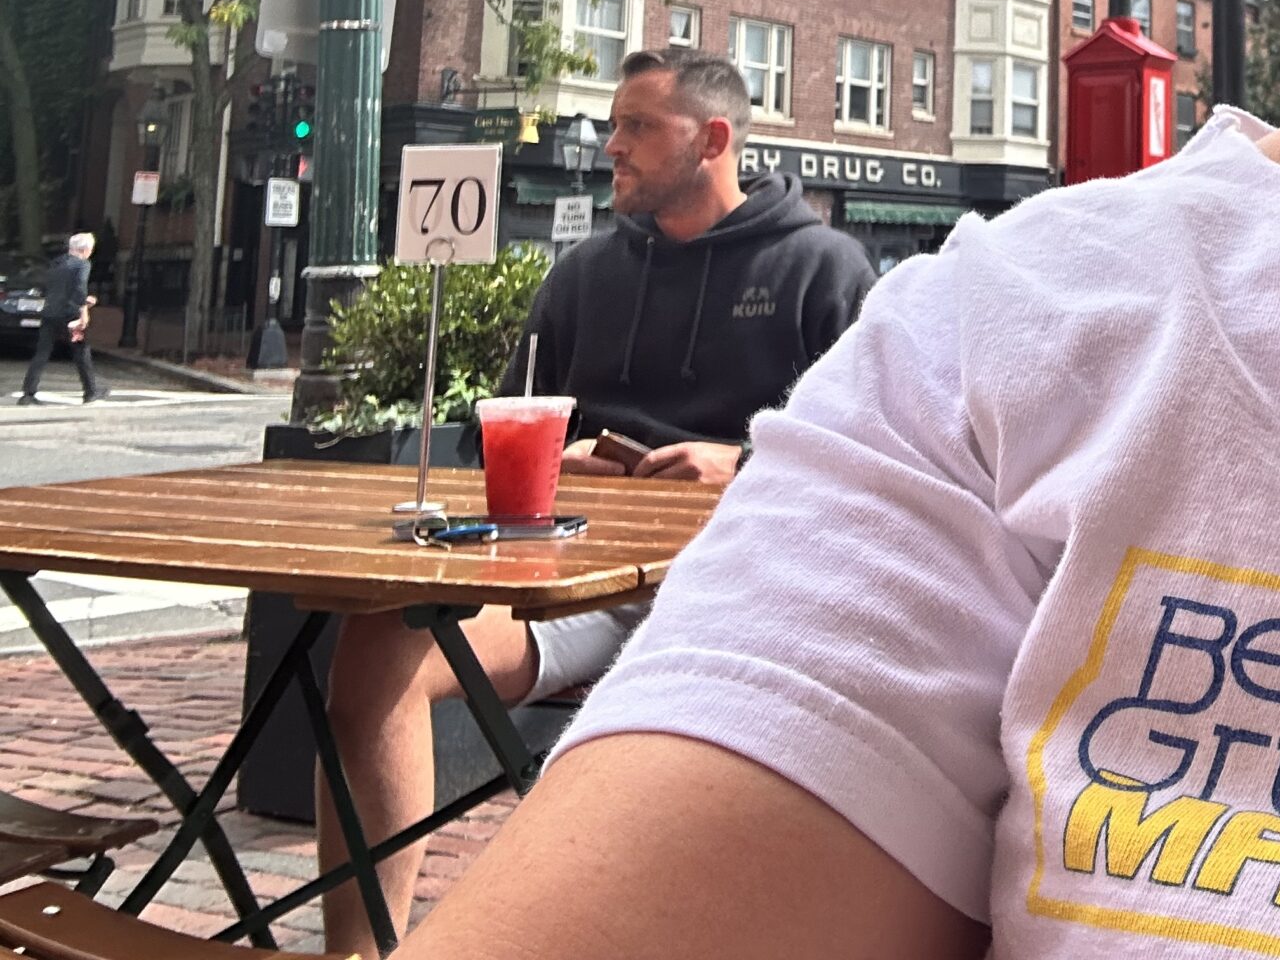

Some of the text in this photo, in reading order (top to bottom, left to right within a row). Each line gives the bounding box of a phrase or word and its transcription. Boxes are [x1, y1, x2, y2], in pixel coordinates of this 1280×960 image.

[741, 147, 942, 188] RY DRUG CO.
[409, 176, 487, 236] 70
[732, 302, 776, 318] KUIU
